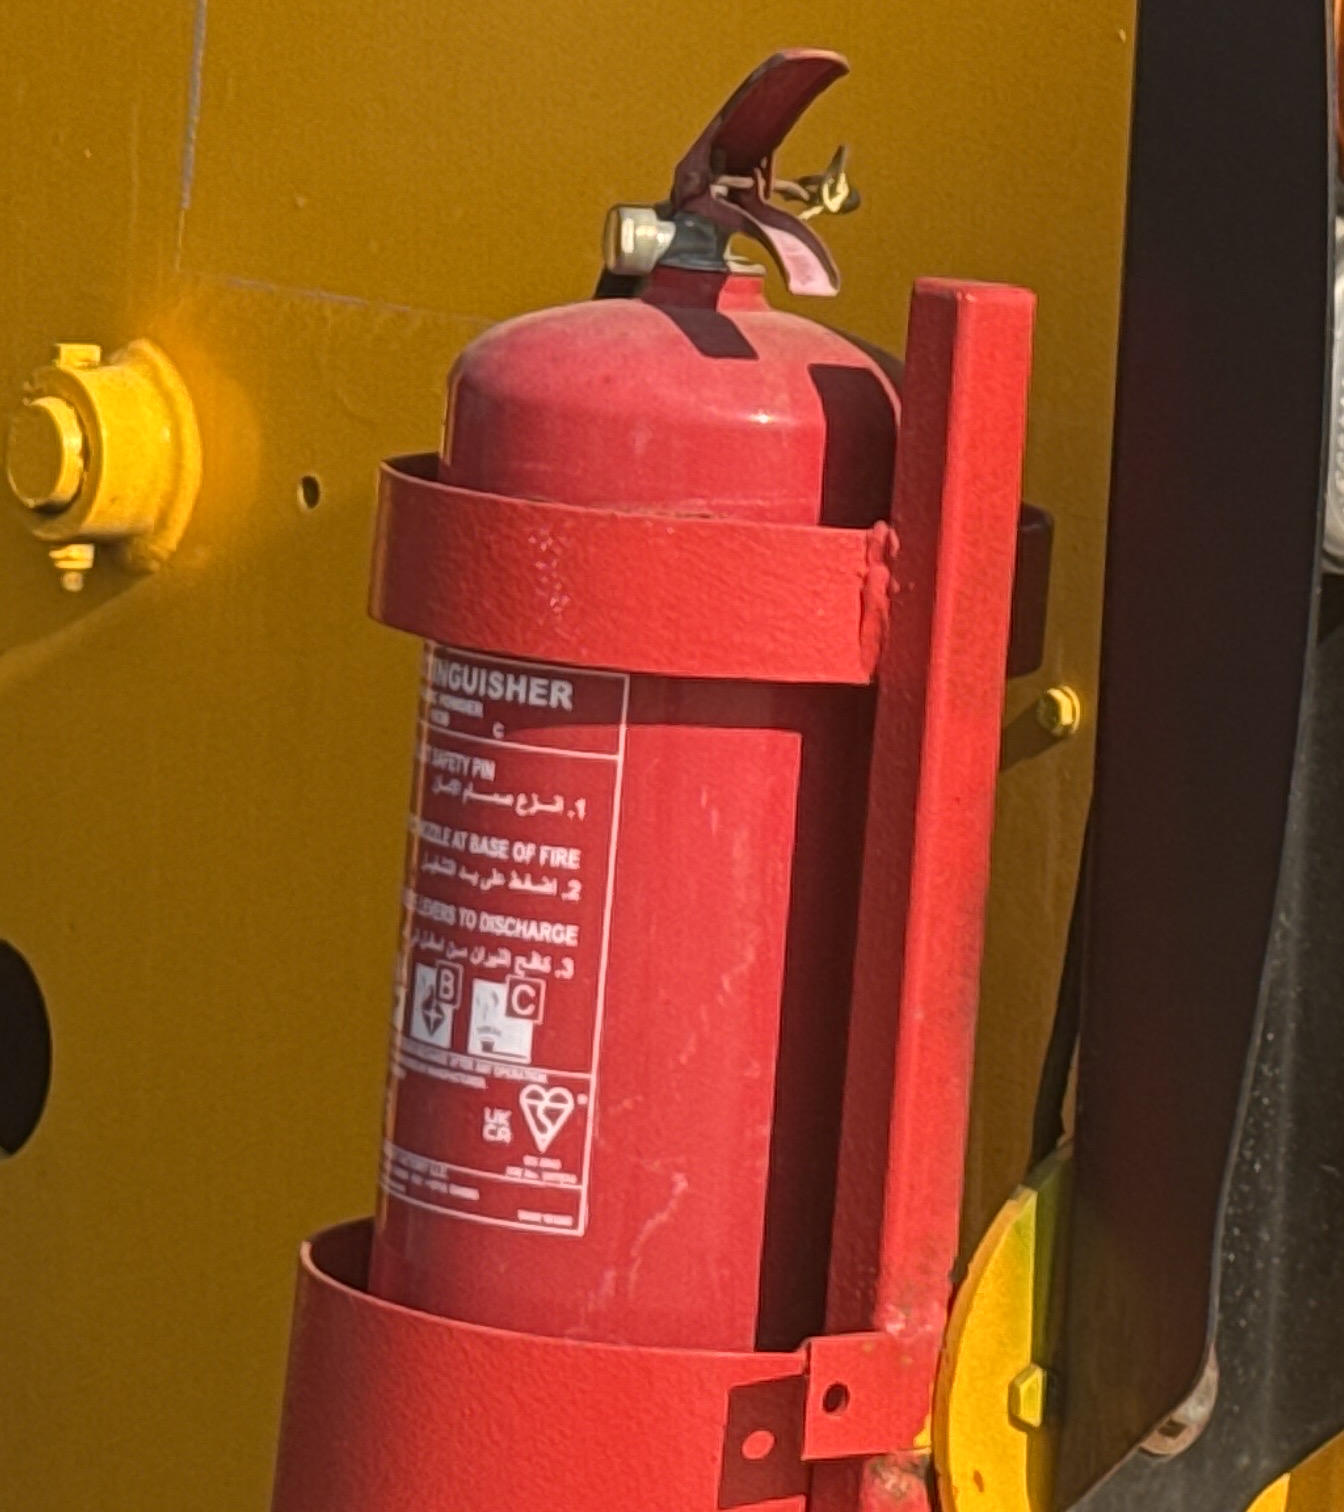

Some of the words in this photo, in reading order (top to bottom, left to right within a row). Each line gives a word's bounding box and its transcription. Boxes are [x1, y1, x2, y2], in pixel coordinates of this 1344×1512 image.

[472, 757, 496, 782] PIN
[451, 830, 469, 851] AT
[469, 832, 509, 860] BASE
[513, 841, 537, 864] OF
[539, 845, 581, 870] FIRE
[459, 907, 477, 931] TO
[479, 911, 579, 947] DISCHARGE
[439, 968, 455, 1001] B
[511, 984, 537, 1016] C
